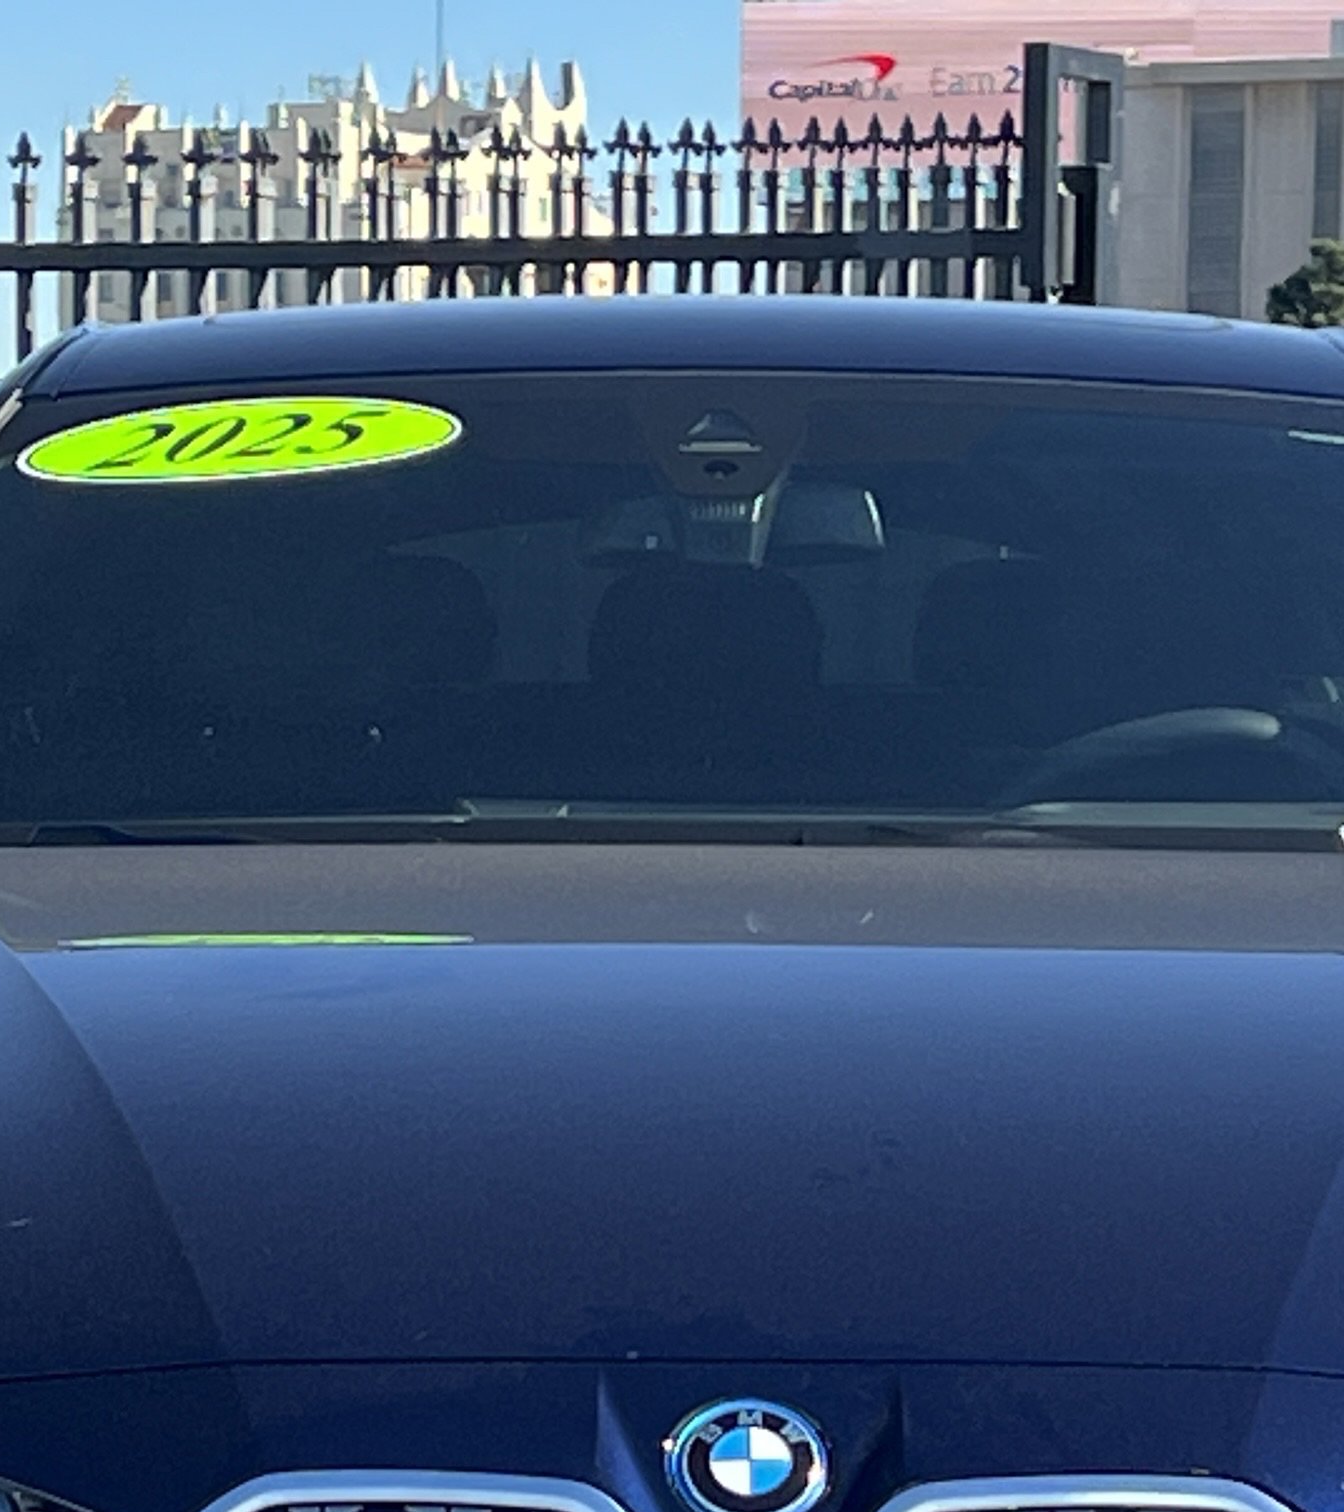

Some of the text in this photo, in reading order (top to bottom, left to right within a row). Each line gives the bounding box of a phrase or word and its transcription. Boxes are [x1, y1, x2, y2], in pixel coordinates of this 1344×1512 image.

[768, 79, 857, 103] Capital
[931, 66, 995, 97] Earn
[85, 410, 391, 471] 2025
